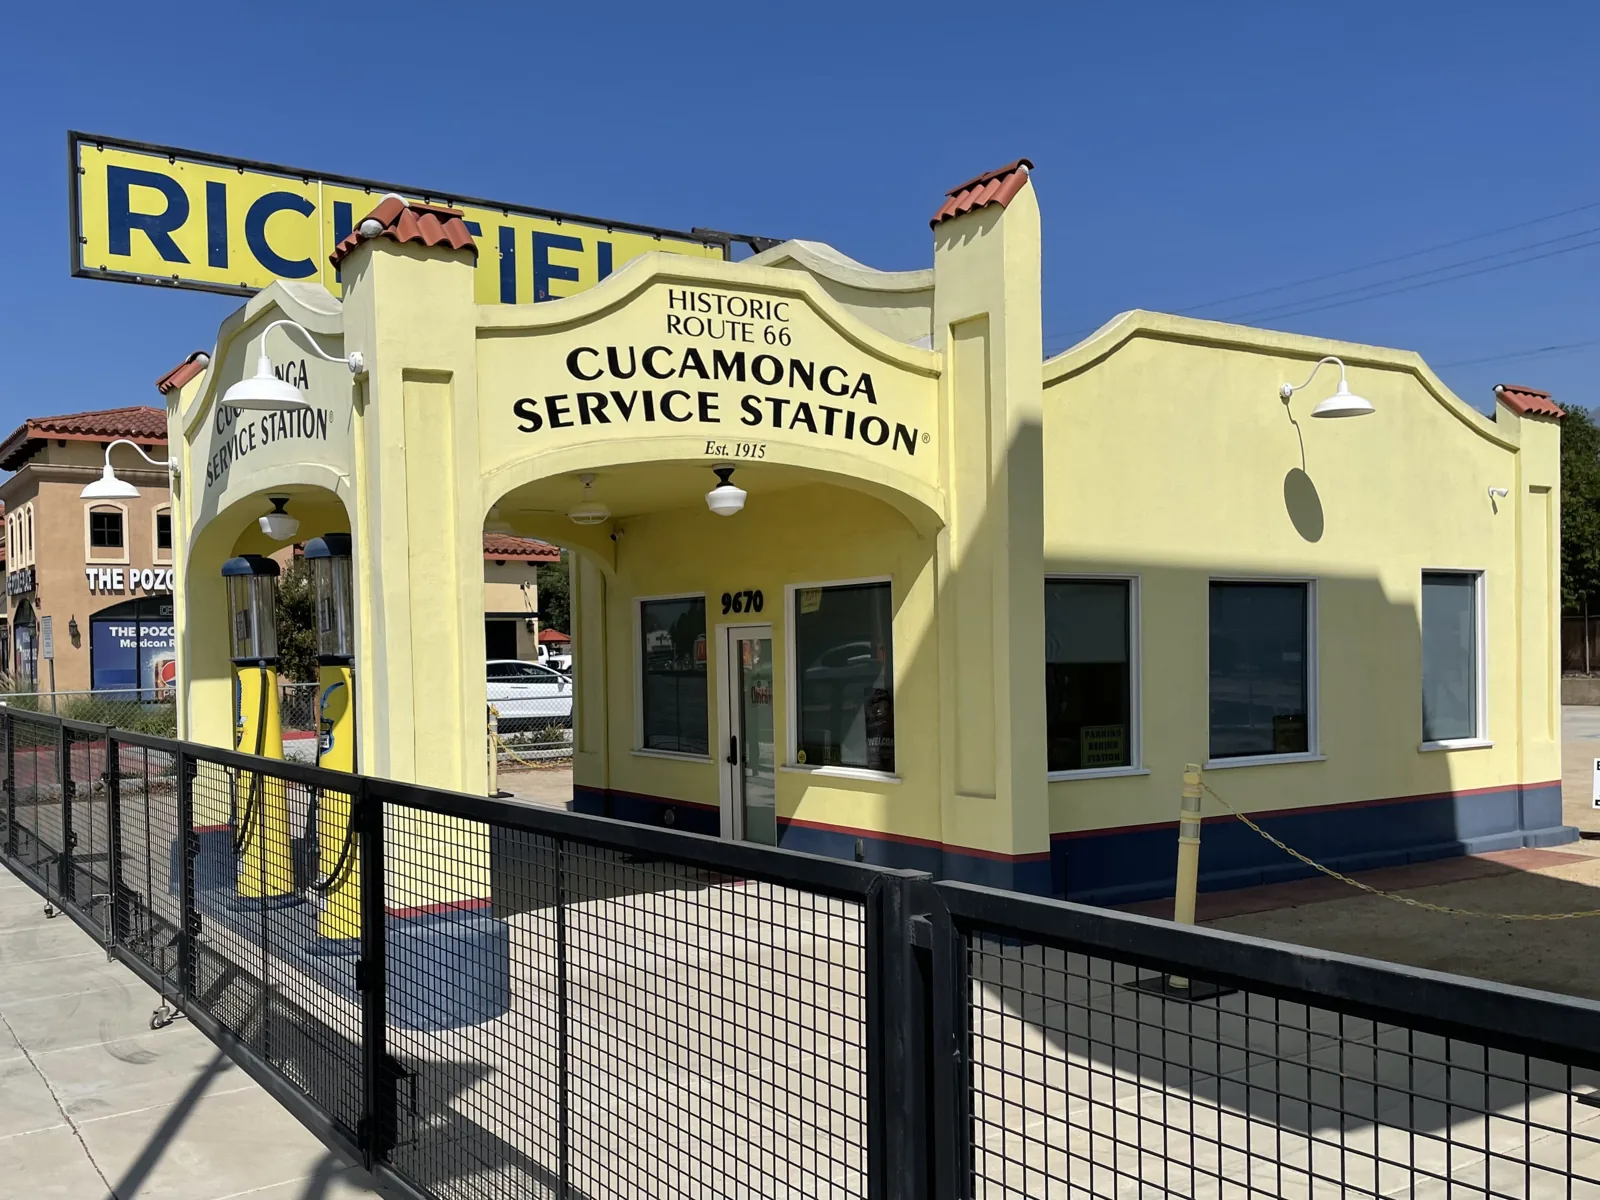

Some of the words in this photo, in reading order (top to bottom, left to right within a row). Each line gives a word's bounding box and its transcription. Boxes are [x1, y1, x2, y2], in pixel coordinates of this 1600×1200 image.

[667, 289, 790, 323] HISTORIC
[666, 314, 755, 344] ROUTE
[763, 324, 792, 347] 66
[566, 345, 878, 405] CUCAMONGA
[513, 389, 721, 433] SERVICE
[206, 422, 257, 488] SERVICE
[703, 440, 729, 457] Est.
[734, 442, 767, 459] 1915
[85, 568, 124, 590] THE
[721, 590, 764, 615] 9670
[109, 626, 137, 637] THE
[120, 639, 167, 648] Mexican
